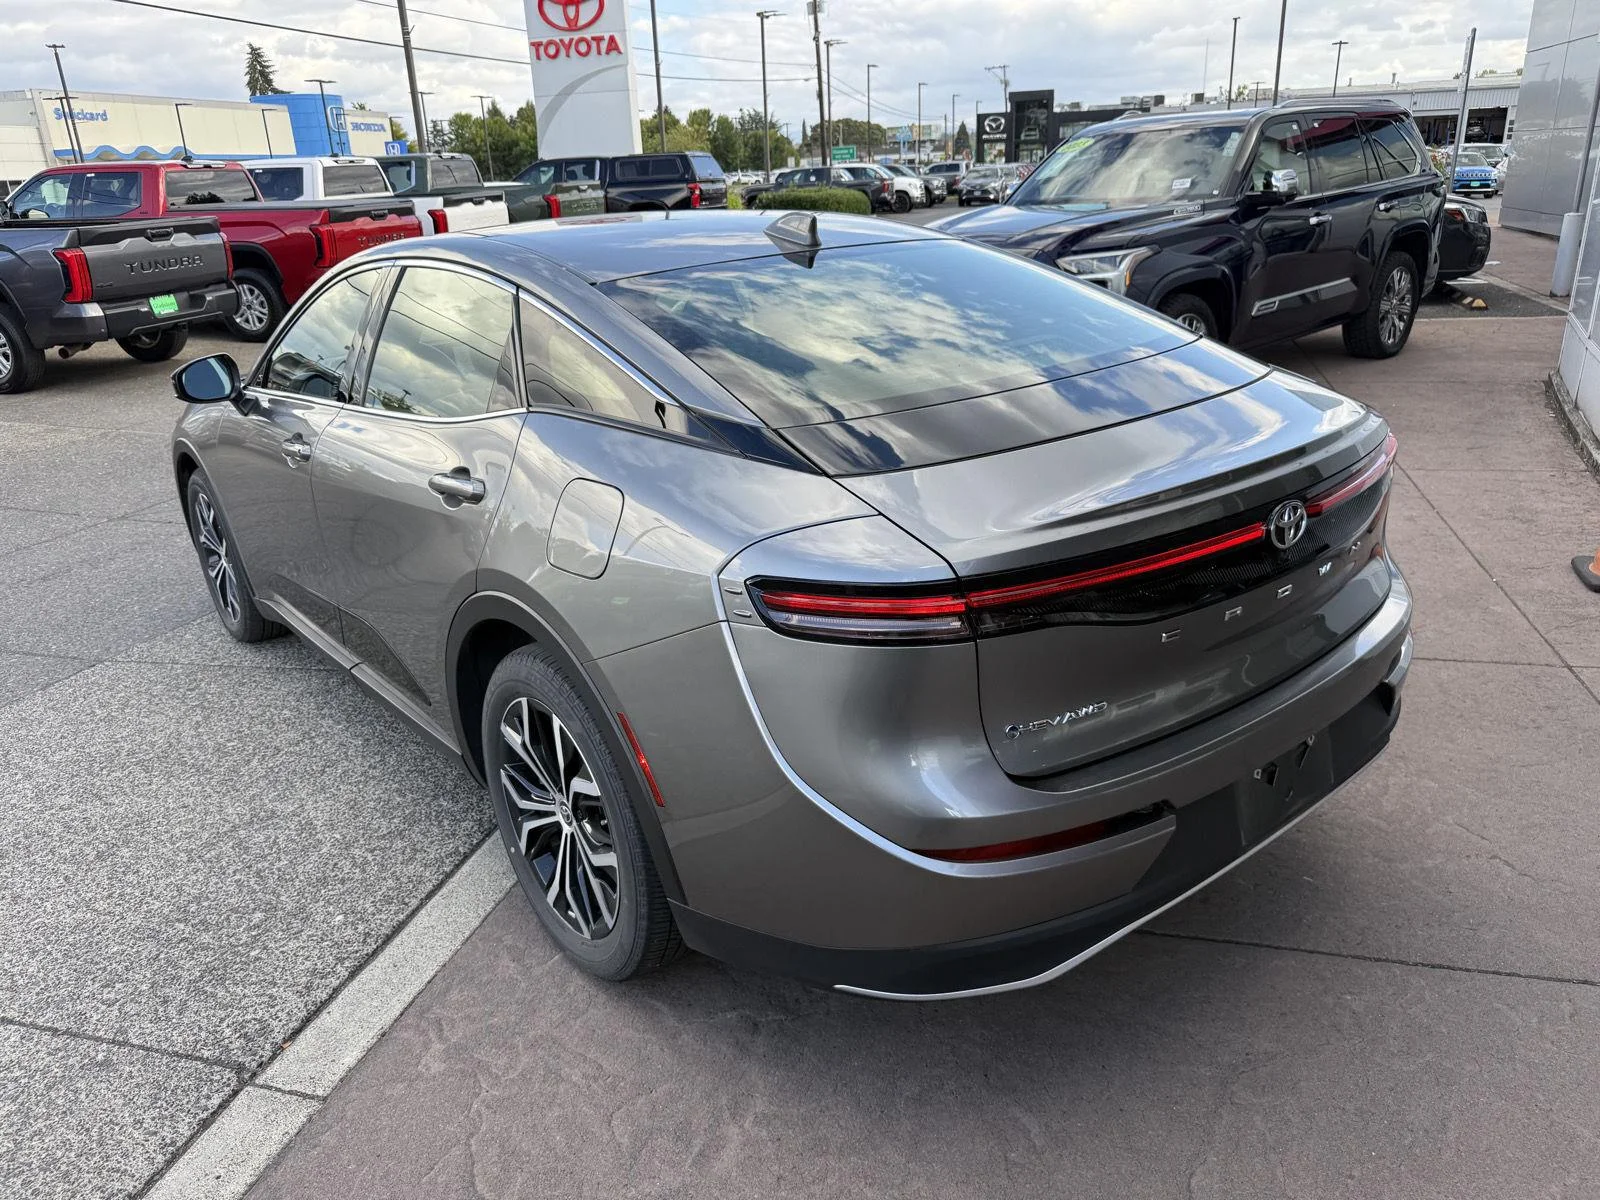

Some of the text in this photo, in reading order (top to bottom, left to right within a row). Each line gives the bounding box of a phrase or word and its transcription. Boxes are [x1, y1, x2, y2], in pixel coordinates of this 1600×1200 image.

[529, 34, 624, 61] TOYOTA
[123, 255, 204, 275] TUNDRA
[1062, 701, 1108, 724] AWD
